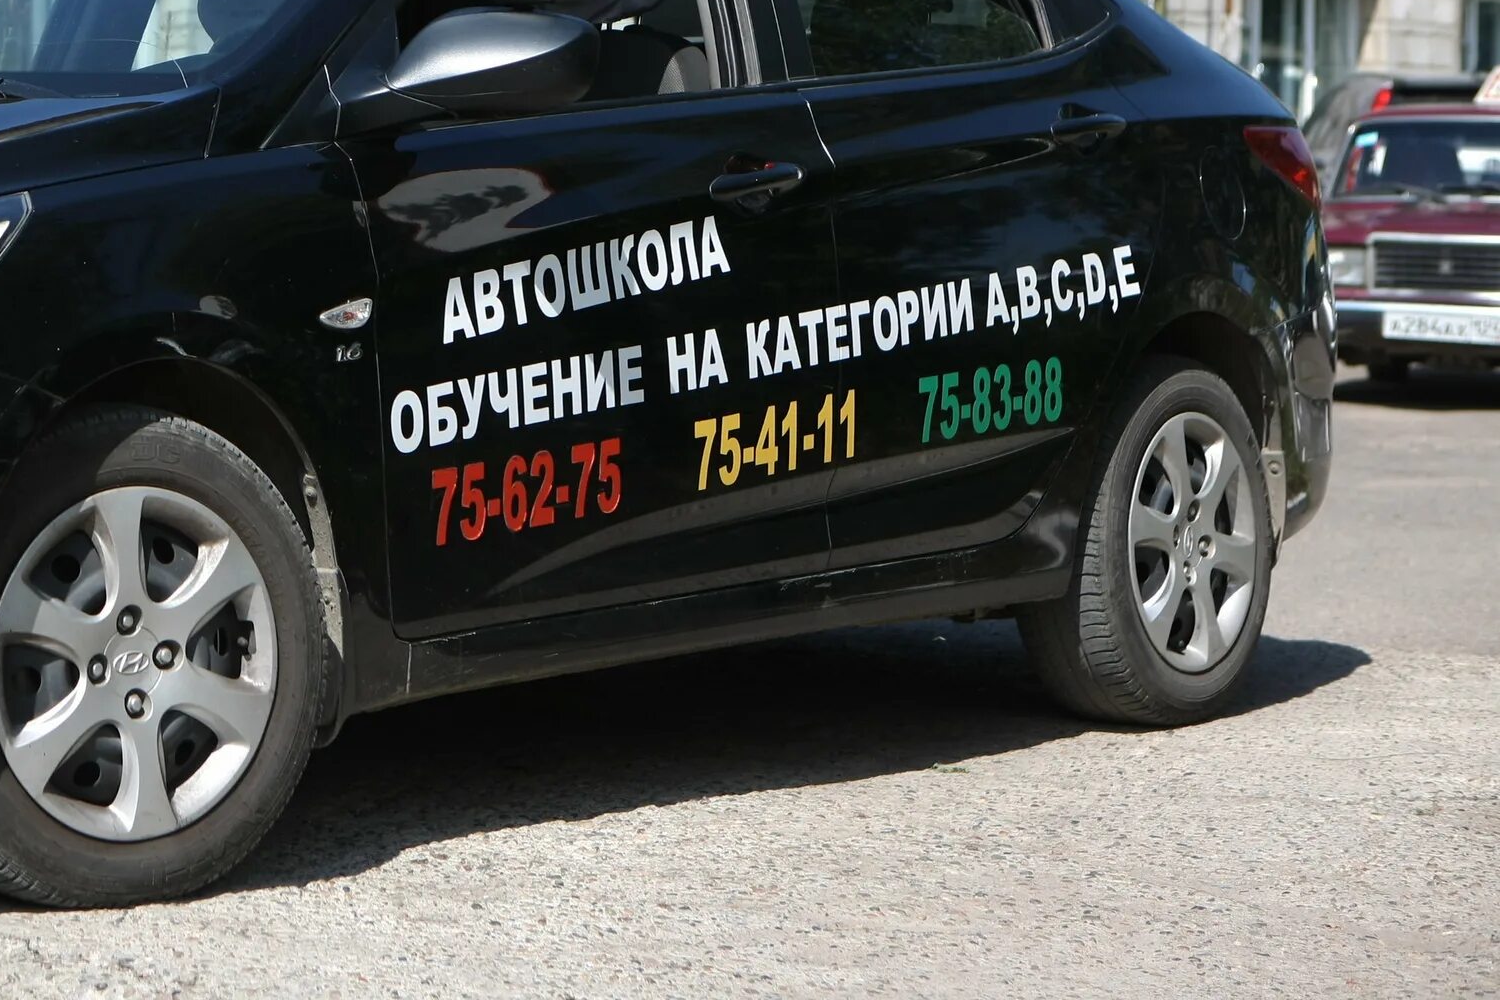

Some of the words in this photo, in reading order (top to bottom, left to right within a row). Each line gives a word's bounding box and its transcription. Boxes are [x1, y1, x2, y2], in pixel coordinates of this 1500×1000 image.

[442, 215, 731, 345] АВТОШКОЛА
[390, 344, 645, 454] ОБУЧЕНИЕ
[666, 328, 729, 394] НА
[746, 278, 975, 379] КАТЕГОРИИ
[918, 356, 1063, 444] 75-83-88
[431, 437, 622, 546] 75-62-75
[694, 389, 855, 491] 75-41-11
